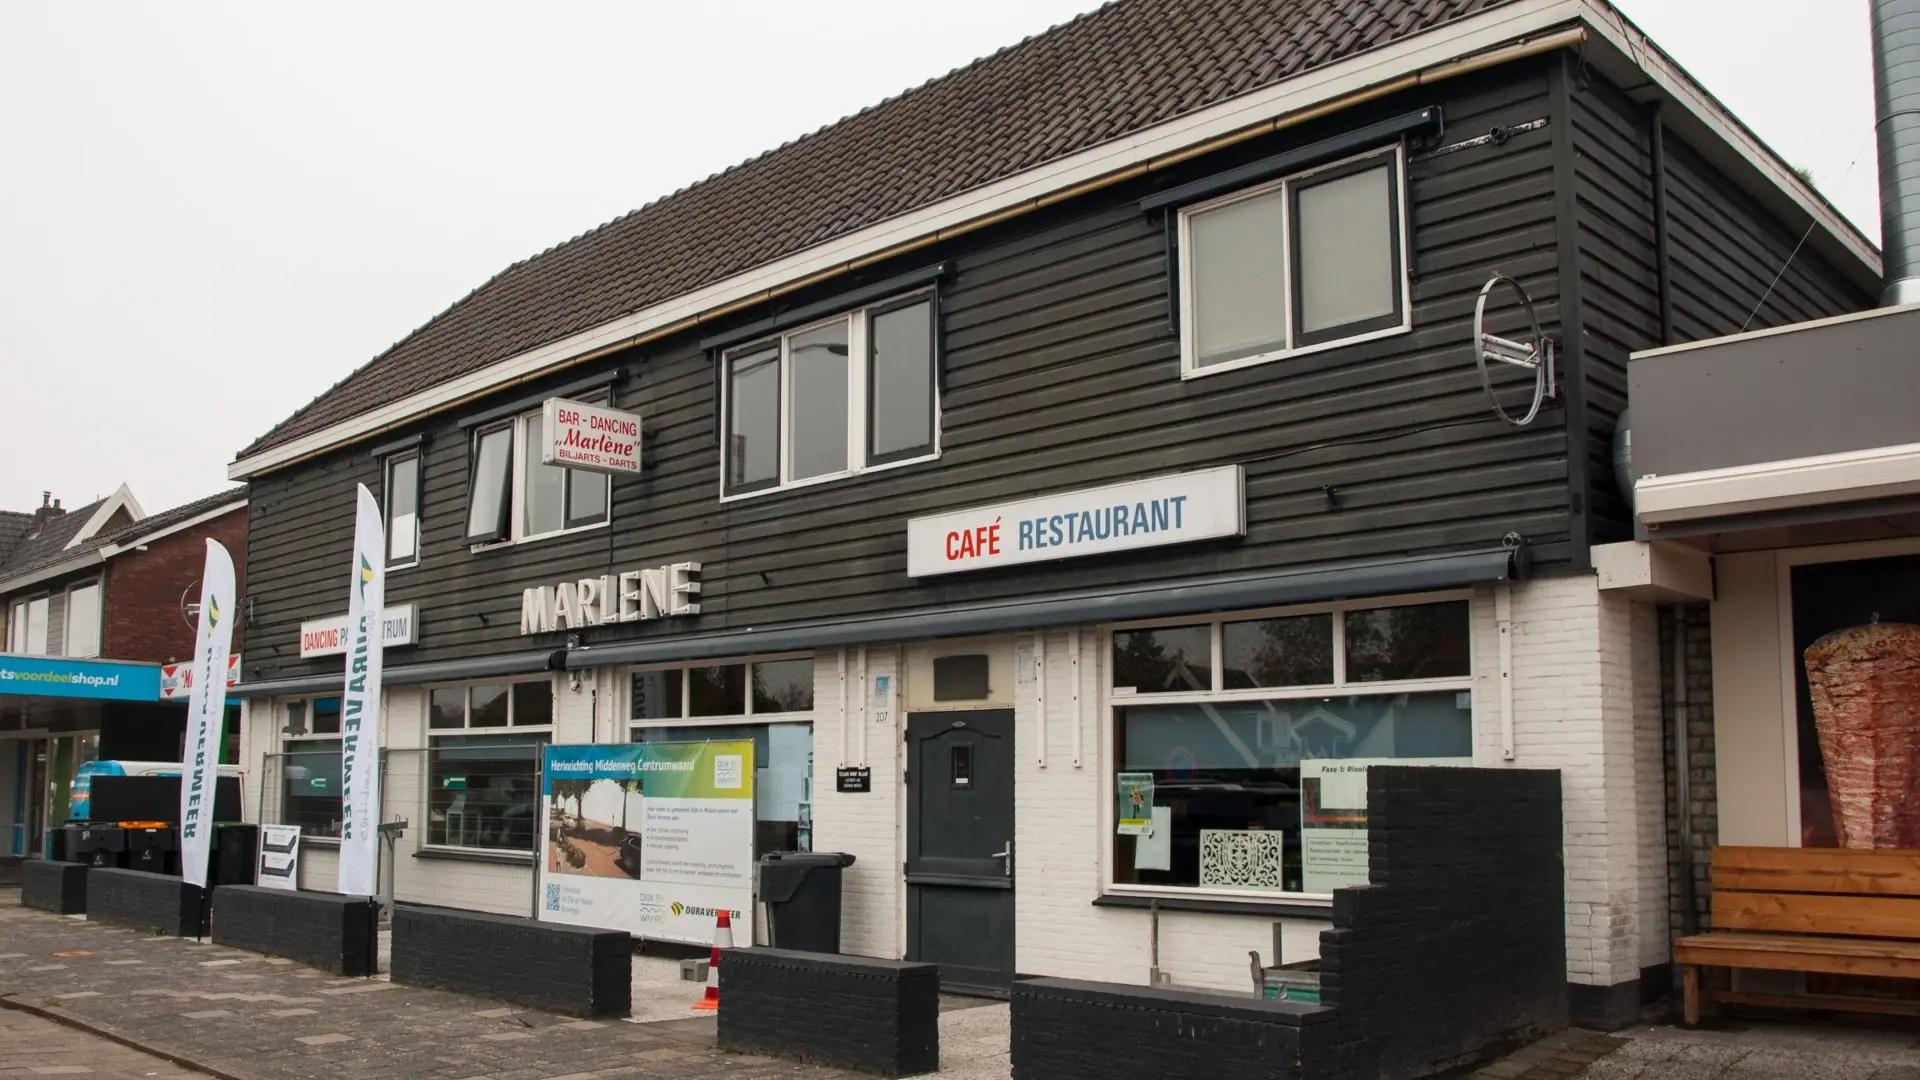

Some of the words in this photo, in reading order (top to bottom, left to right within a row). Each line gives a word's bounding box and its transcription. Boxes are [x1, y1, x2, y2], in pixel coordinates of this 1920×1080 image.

[559, 409, 579, 426] BAR
[590, 415, 637, 437] DANCING
[559, 449, 601, 464] BILJARTS
[609, 457, 637, 470] DARTS
[945, 516, 1002, 561] CAFÉ
[1018, 495, 1187, 551] RESTAURANT
[520, 561, 701, 635] MARLENE
[304, 628, 338, 651] DANCING
[0, 668, 119, 688] tsvoordeelshop.nl
[875, 711, 888, 722] 207
[551, 759, 593, 773] Herinrichting
[595, 759, 636, 773] Middenweg
[638, 758, 695, 772] Centrumwaard
